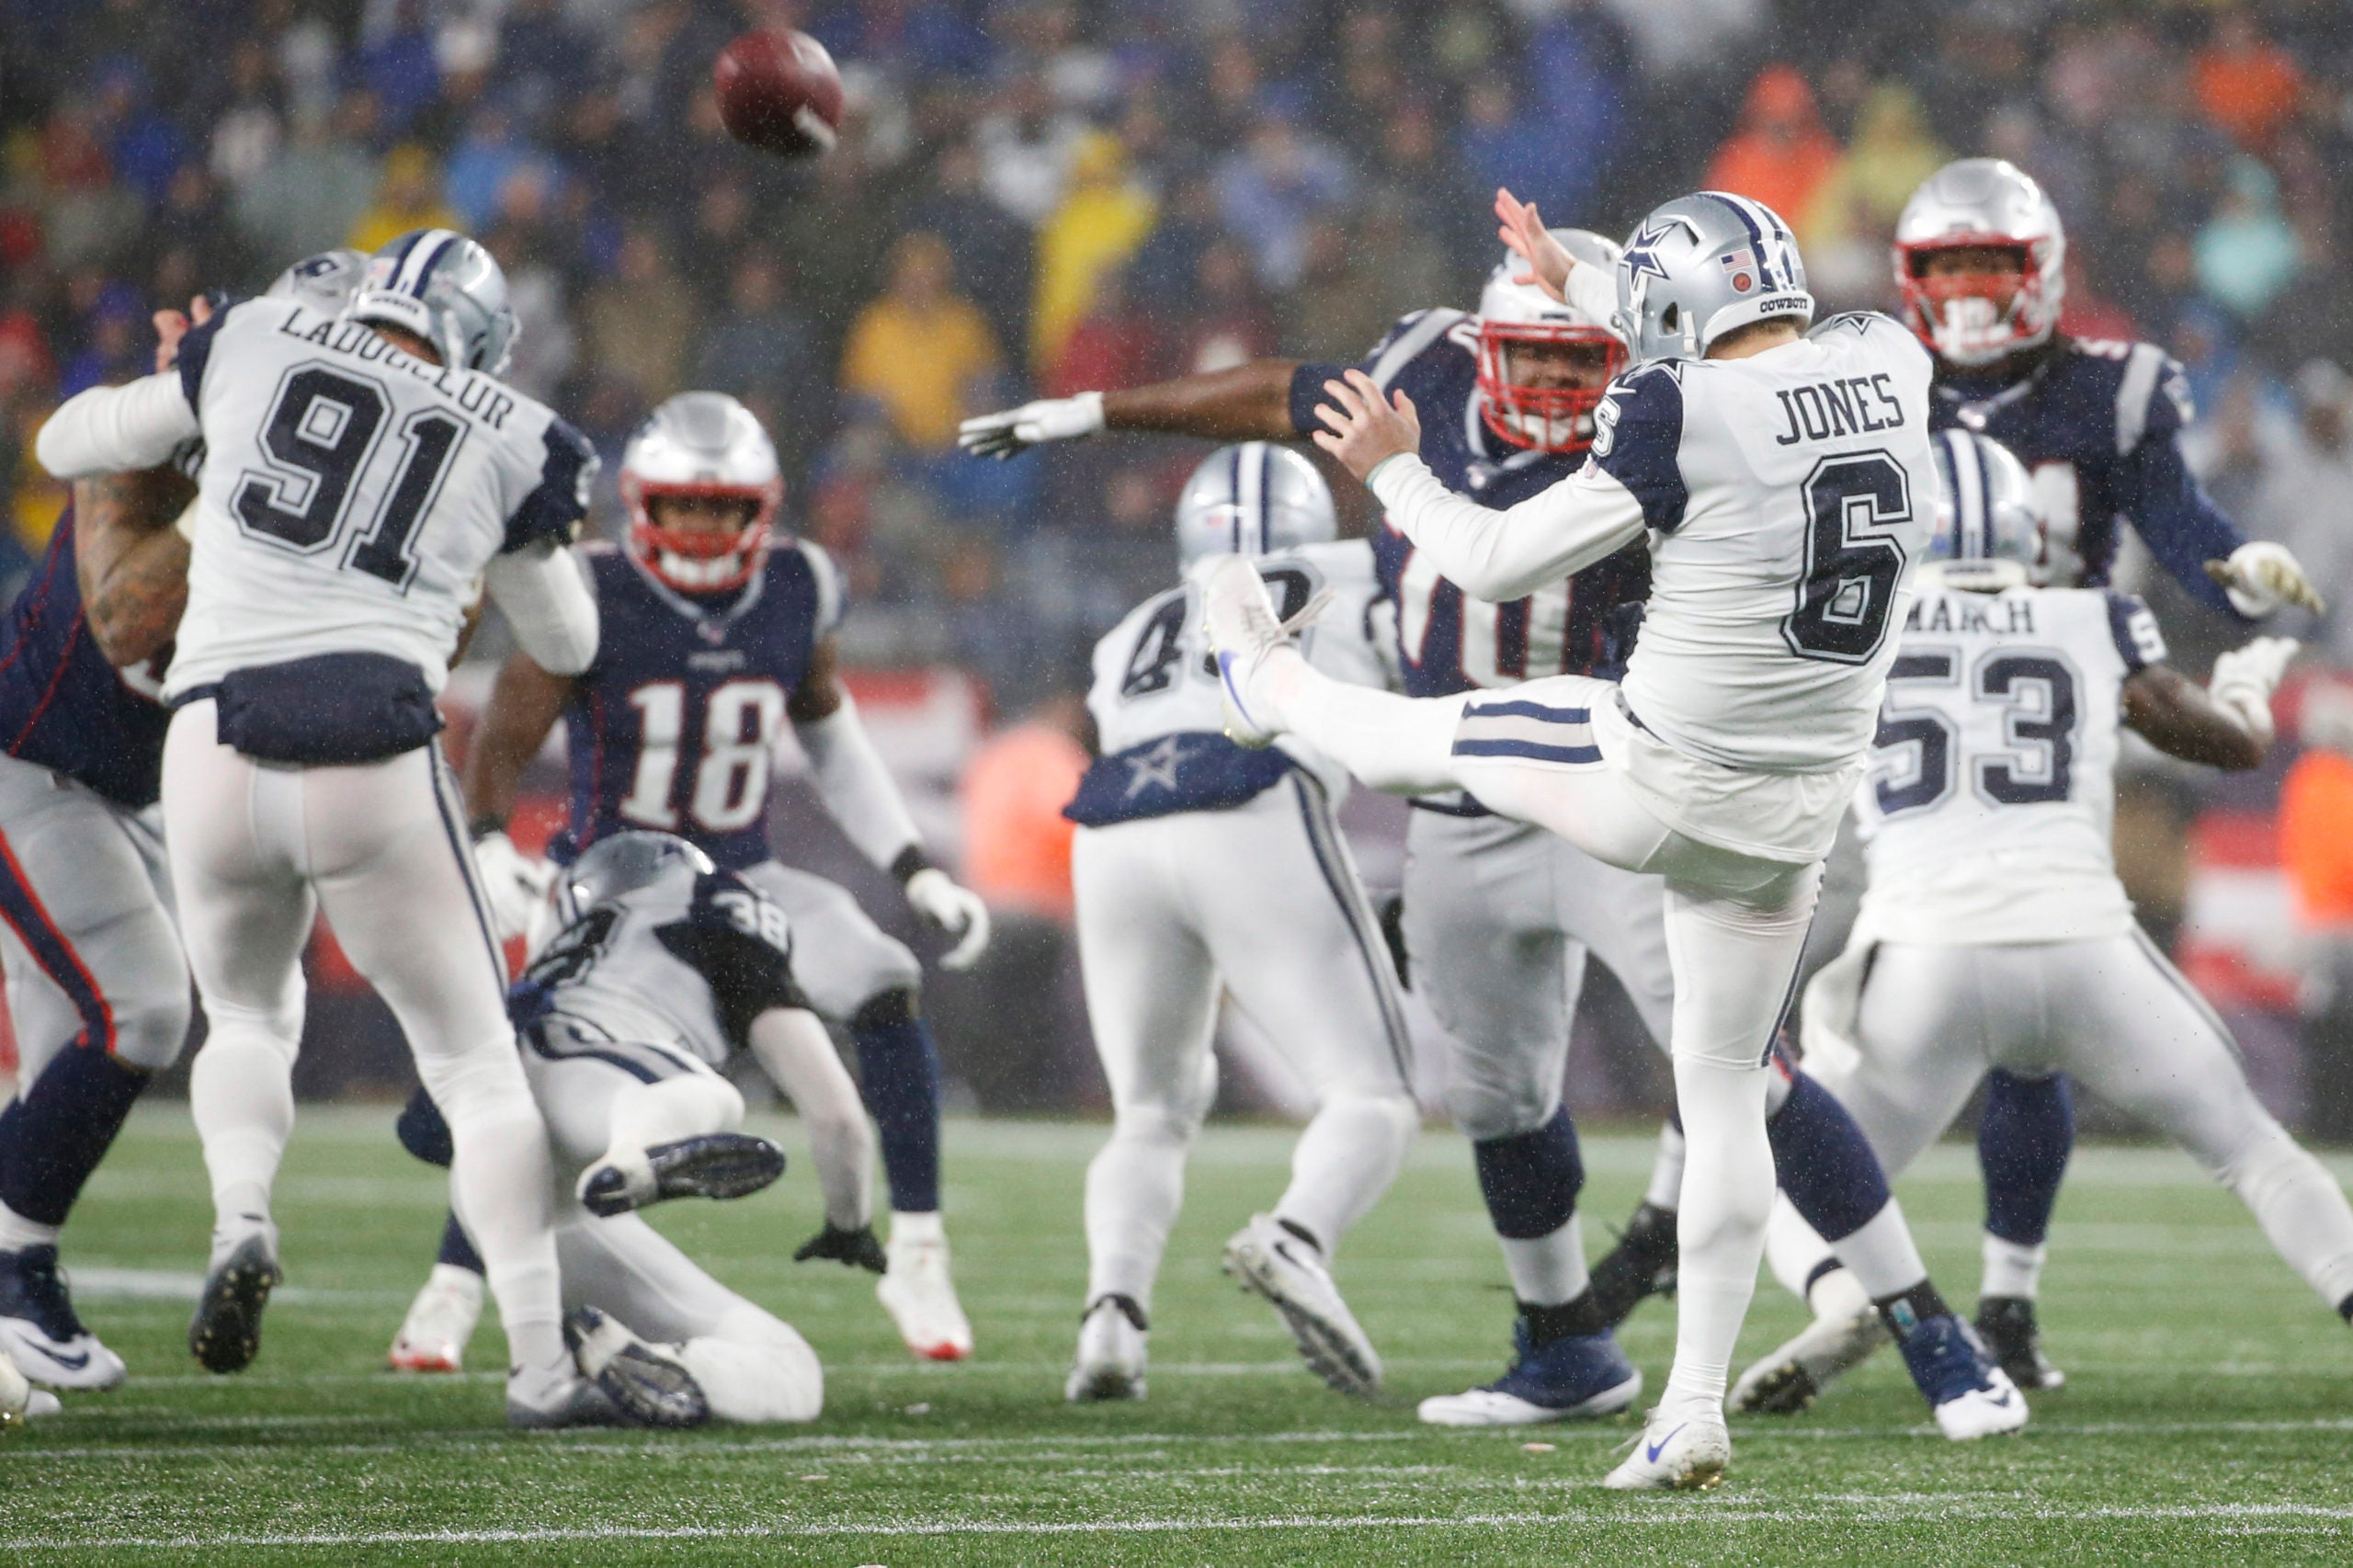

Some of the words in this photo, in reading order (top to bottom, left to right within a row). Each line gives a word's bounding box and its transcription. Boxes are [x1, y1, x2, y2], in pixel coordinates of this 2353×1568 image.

[229, 358, 472, 597] 91
[1776, 372, 1904, 446] JONES
[1779, 448, 1913, 665] 6
[617, 676, 788, 834] 18
[1866, 644, 2086, 821] 53
[710, 889, 790, 954] 38
